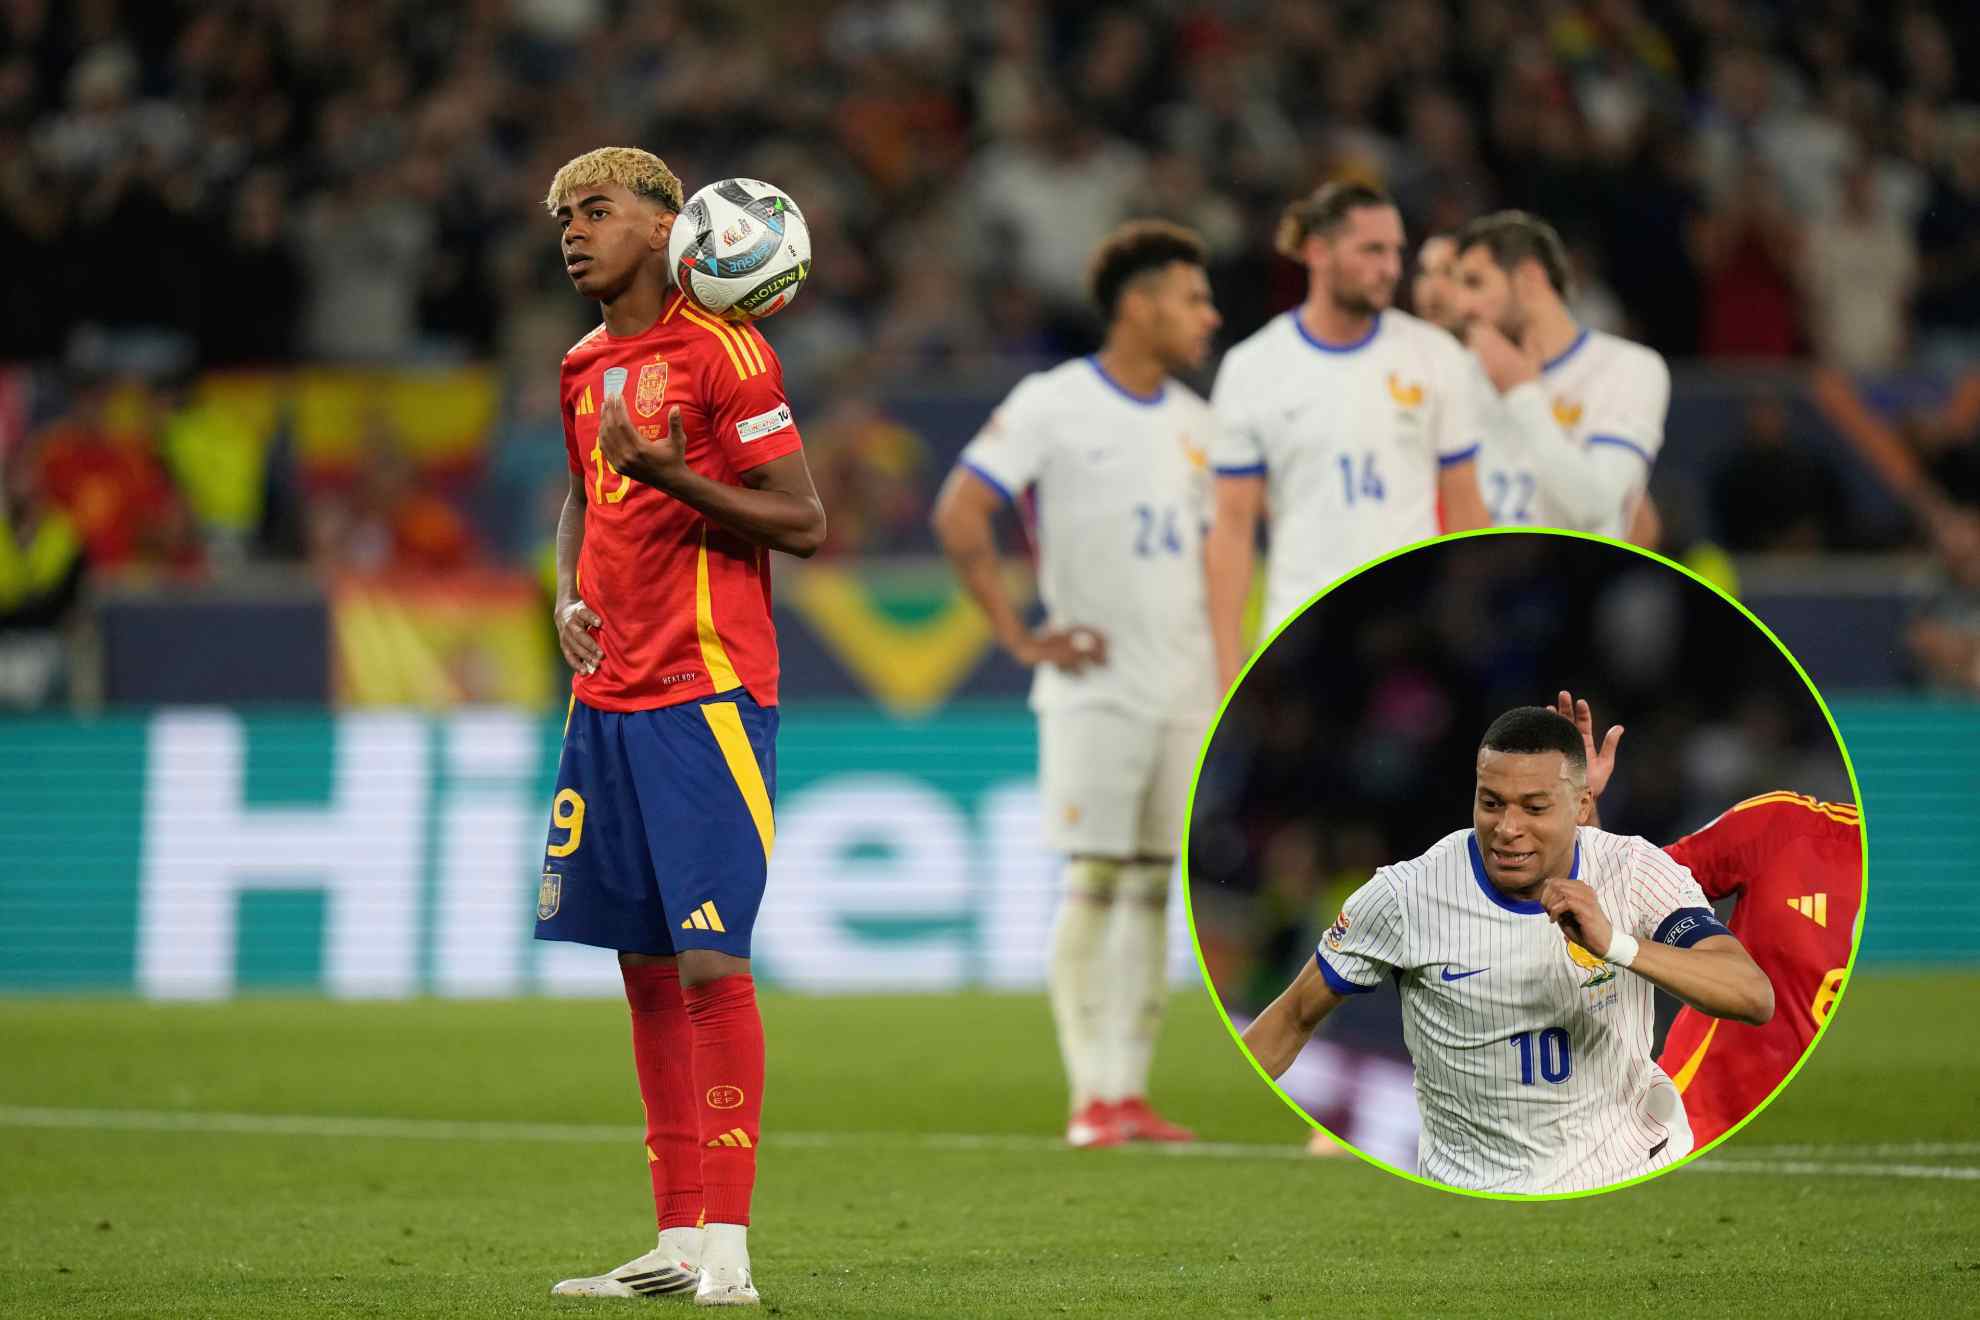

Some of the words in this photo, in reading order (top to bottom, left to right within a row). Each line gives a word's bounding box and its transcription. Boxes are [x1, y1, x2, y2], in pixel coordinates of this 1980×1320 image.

[728, 241, 770, 273] EAGUE
[743, 271, 795, 306] NATIONS
[1336, 452, 1387, 505] 14
[1132, 503, 1184, 560] 24
[547, 787, 586, 857] 9
[1509, 1026, 1573, 1086] 10
